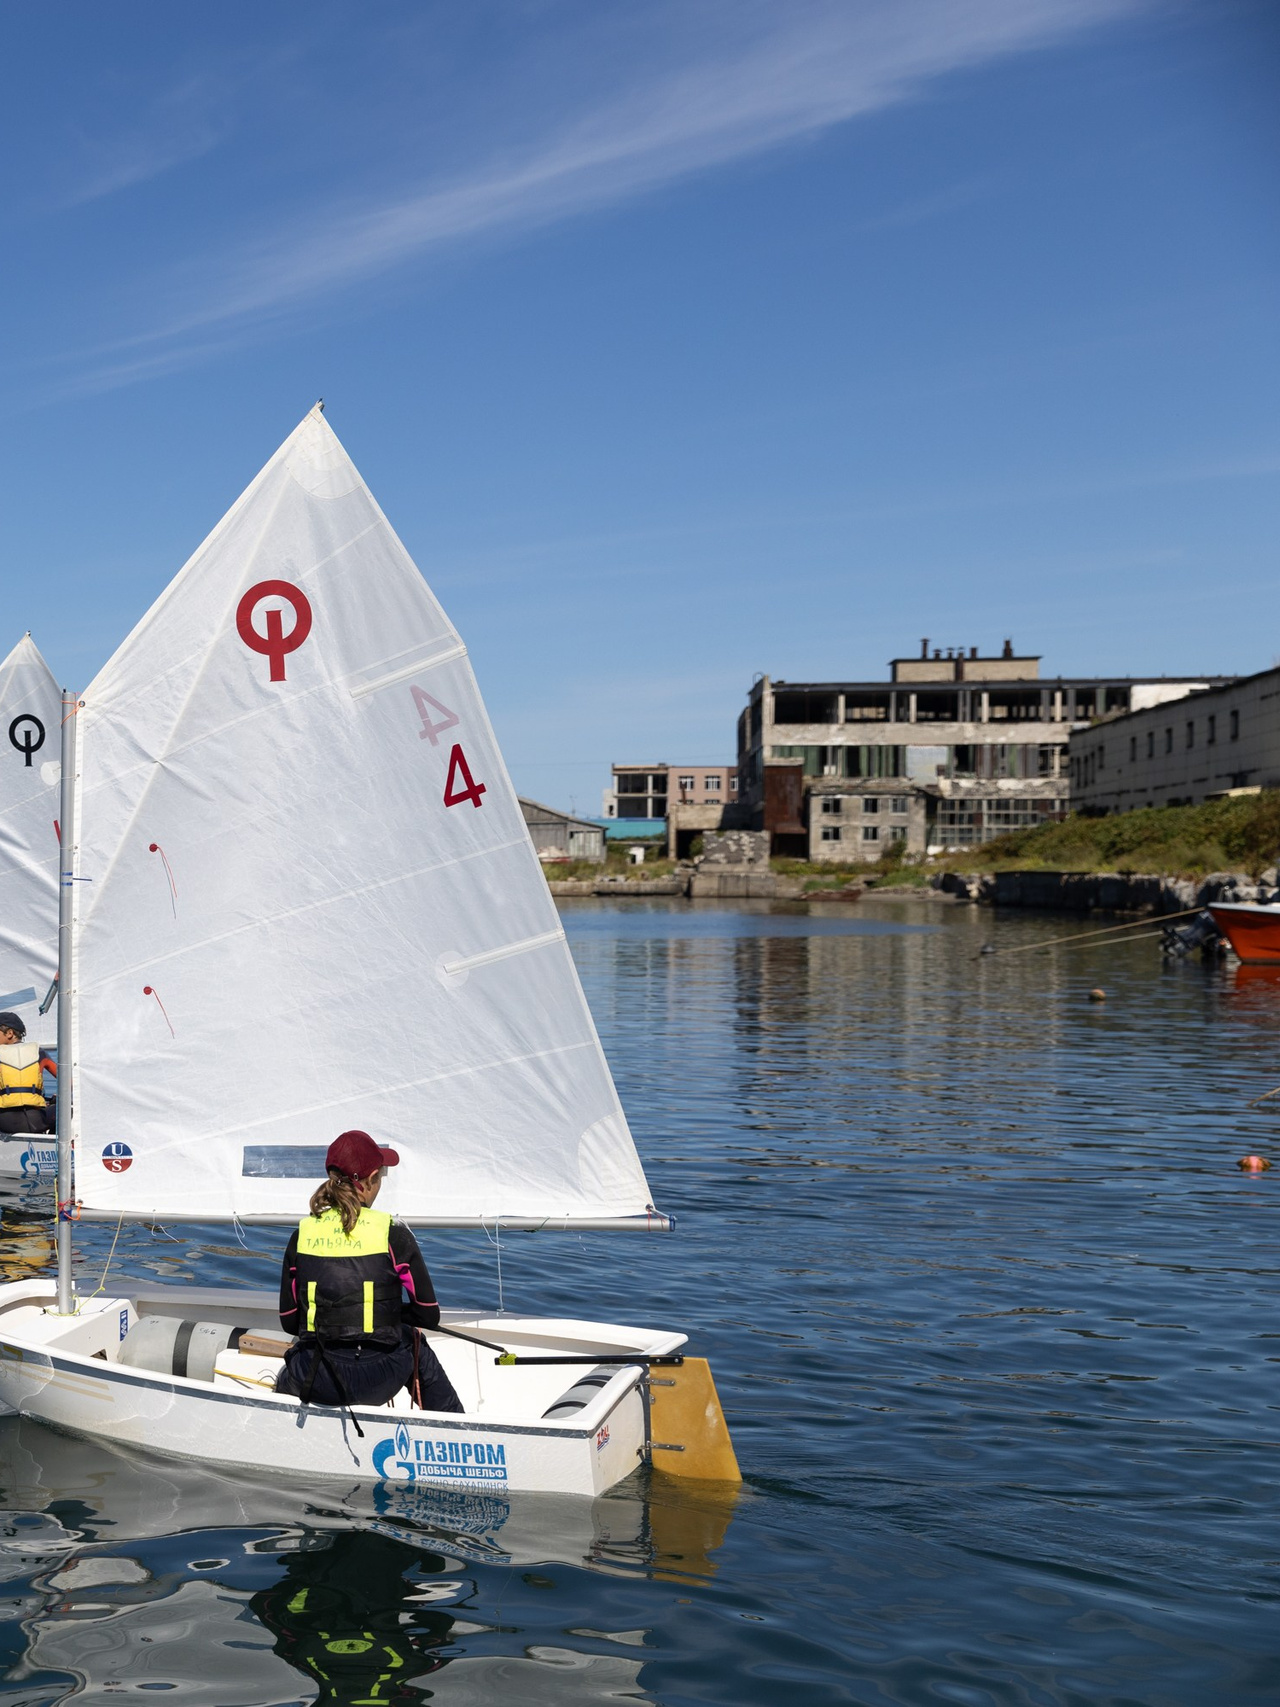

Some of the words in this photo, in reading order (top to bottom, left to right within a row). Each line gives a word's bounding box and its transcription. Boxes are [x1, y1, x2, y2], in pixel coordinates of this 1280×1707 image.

[443, 743, 487, 808] 4
[111, 1160, 123, 1172] S
[306, 1237, 362, 1250] ТАТЬЯНА
[414, 1440, 506, 1465] ГАЗПРОМ
[420, 1465, 463, 1477] ДОБЫЧА
[465, 1467, 505, 1478] ШЕЛЬФ
